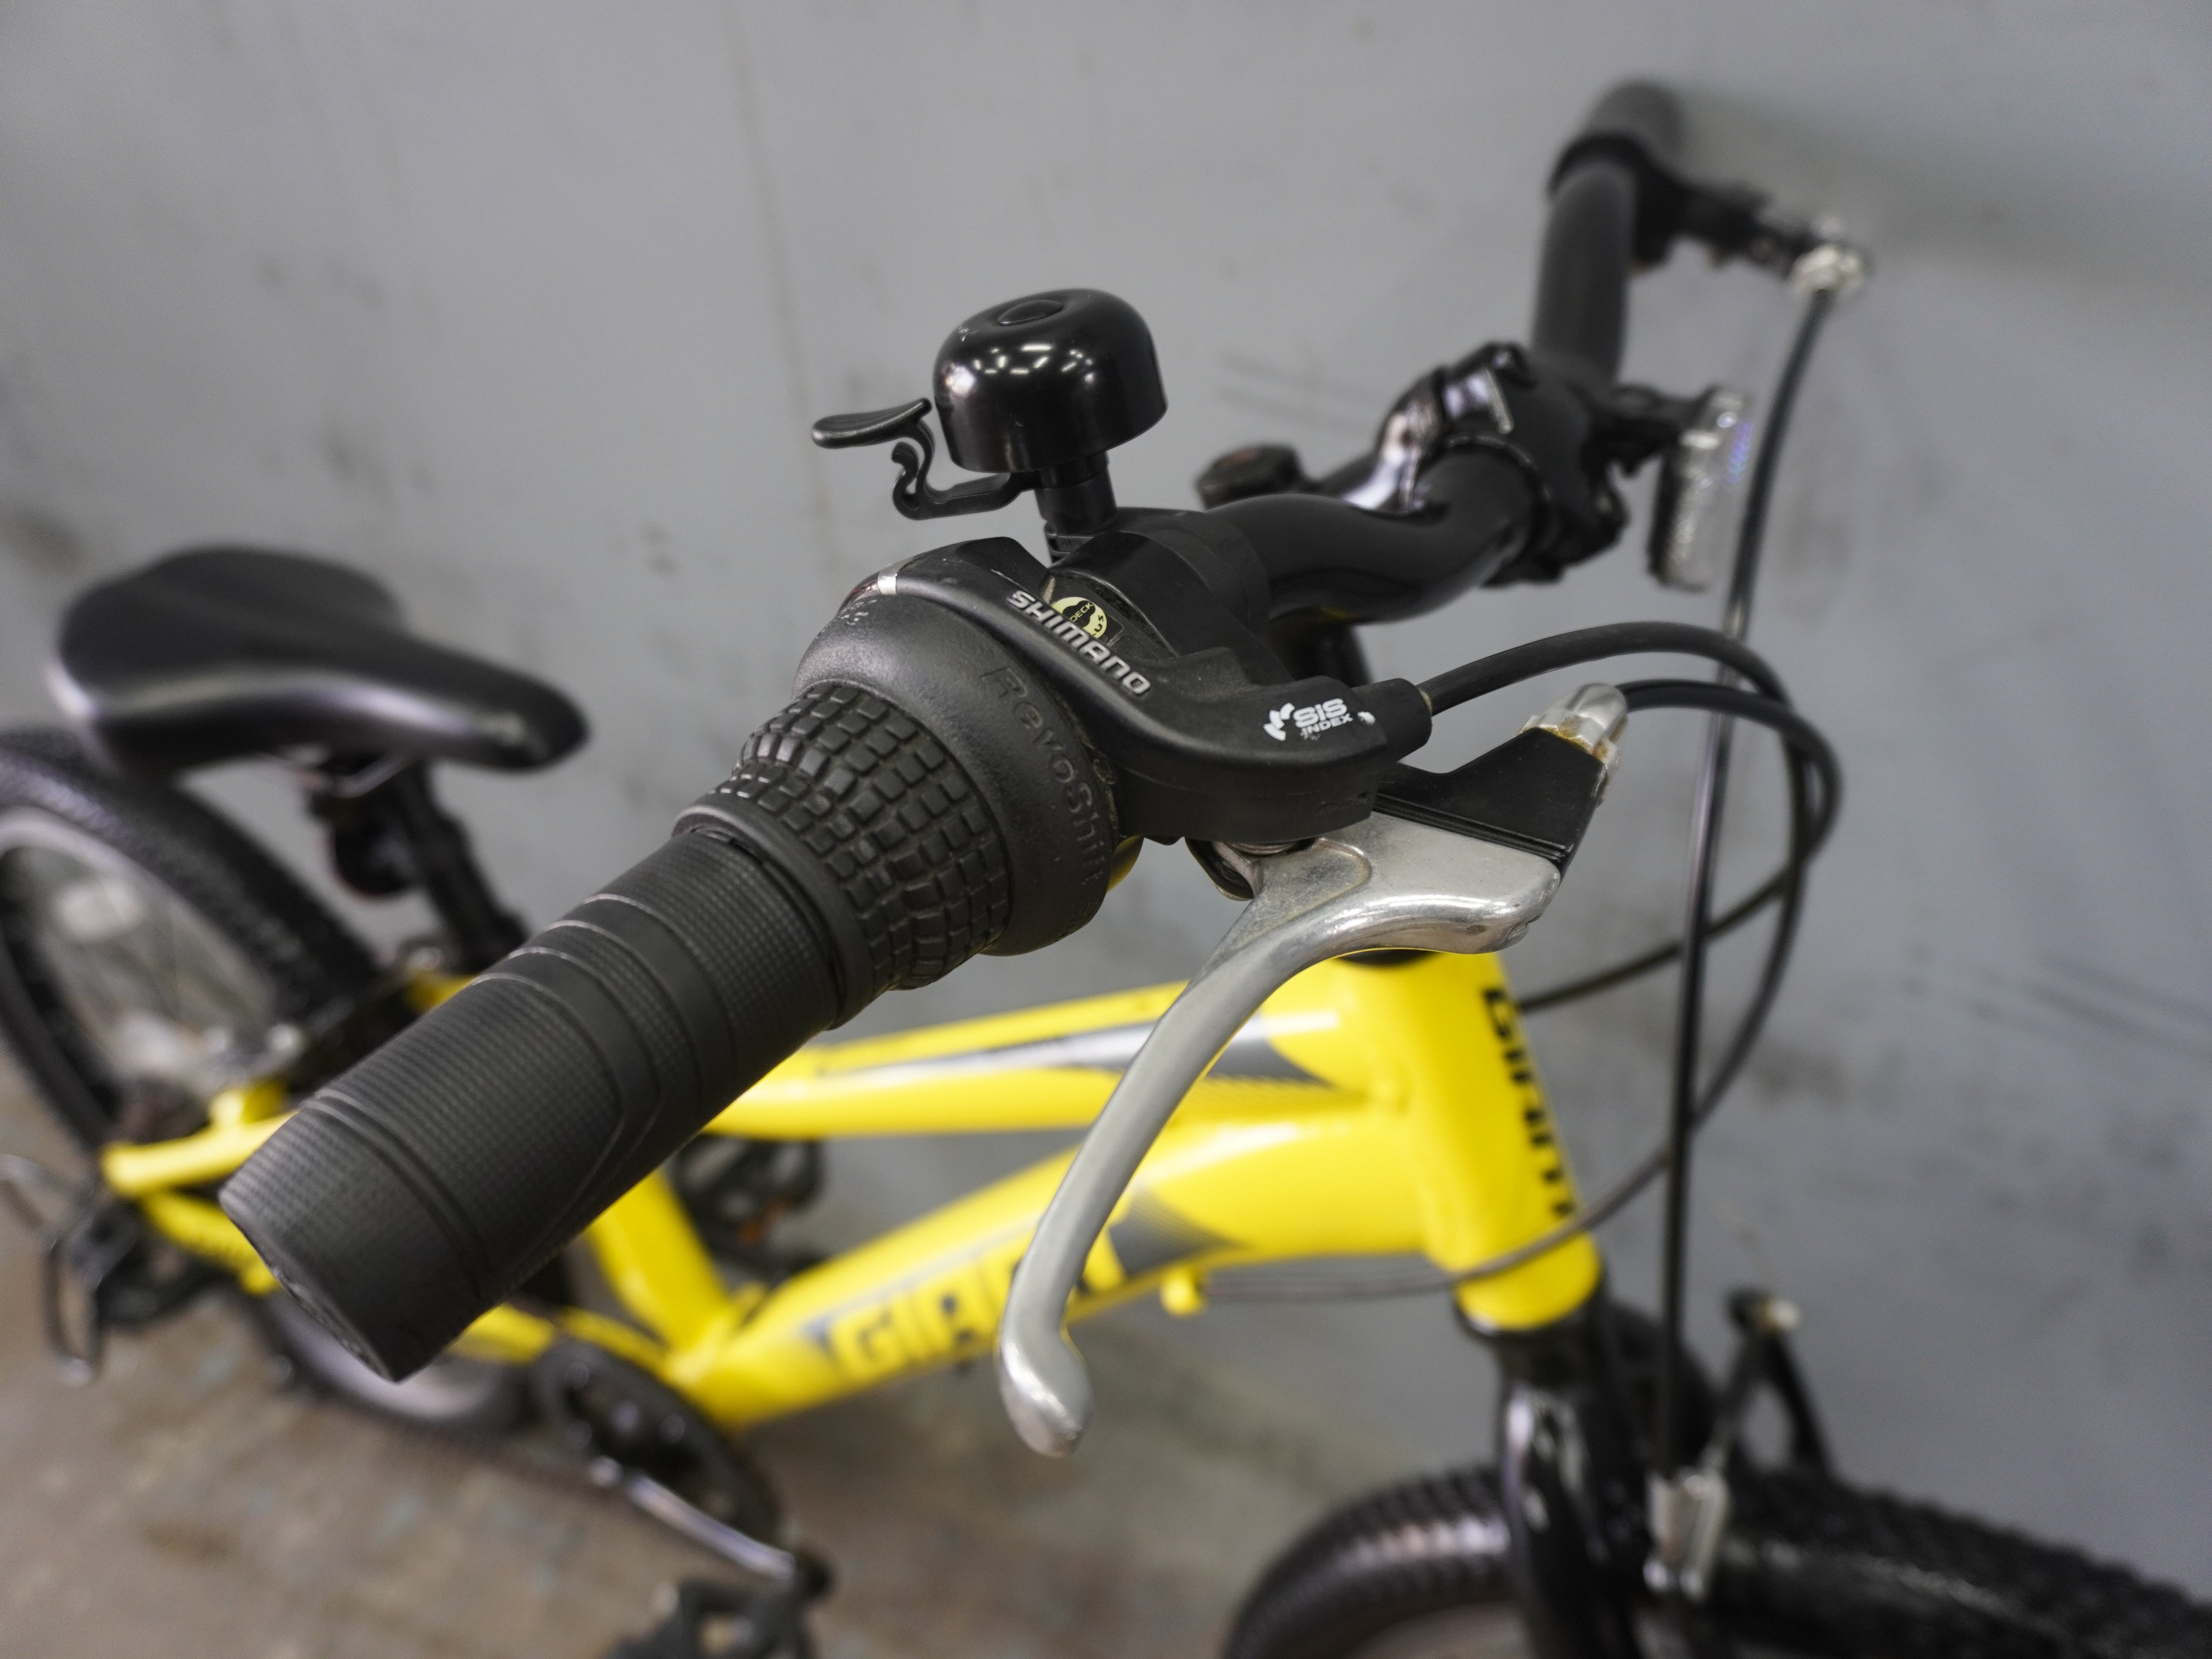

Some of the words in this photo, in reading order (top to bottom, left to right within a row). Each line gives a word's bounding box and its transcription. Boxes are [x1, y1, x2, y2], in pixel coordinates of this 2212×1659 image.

[1070, 602, 1093, 622] DECK
[1006, 590, 1151, 694] SHIMANO
[1300, 713, 1353, 738] INDEX
